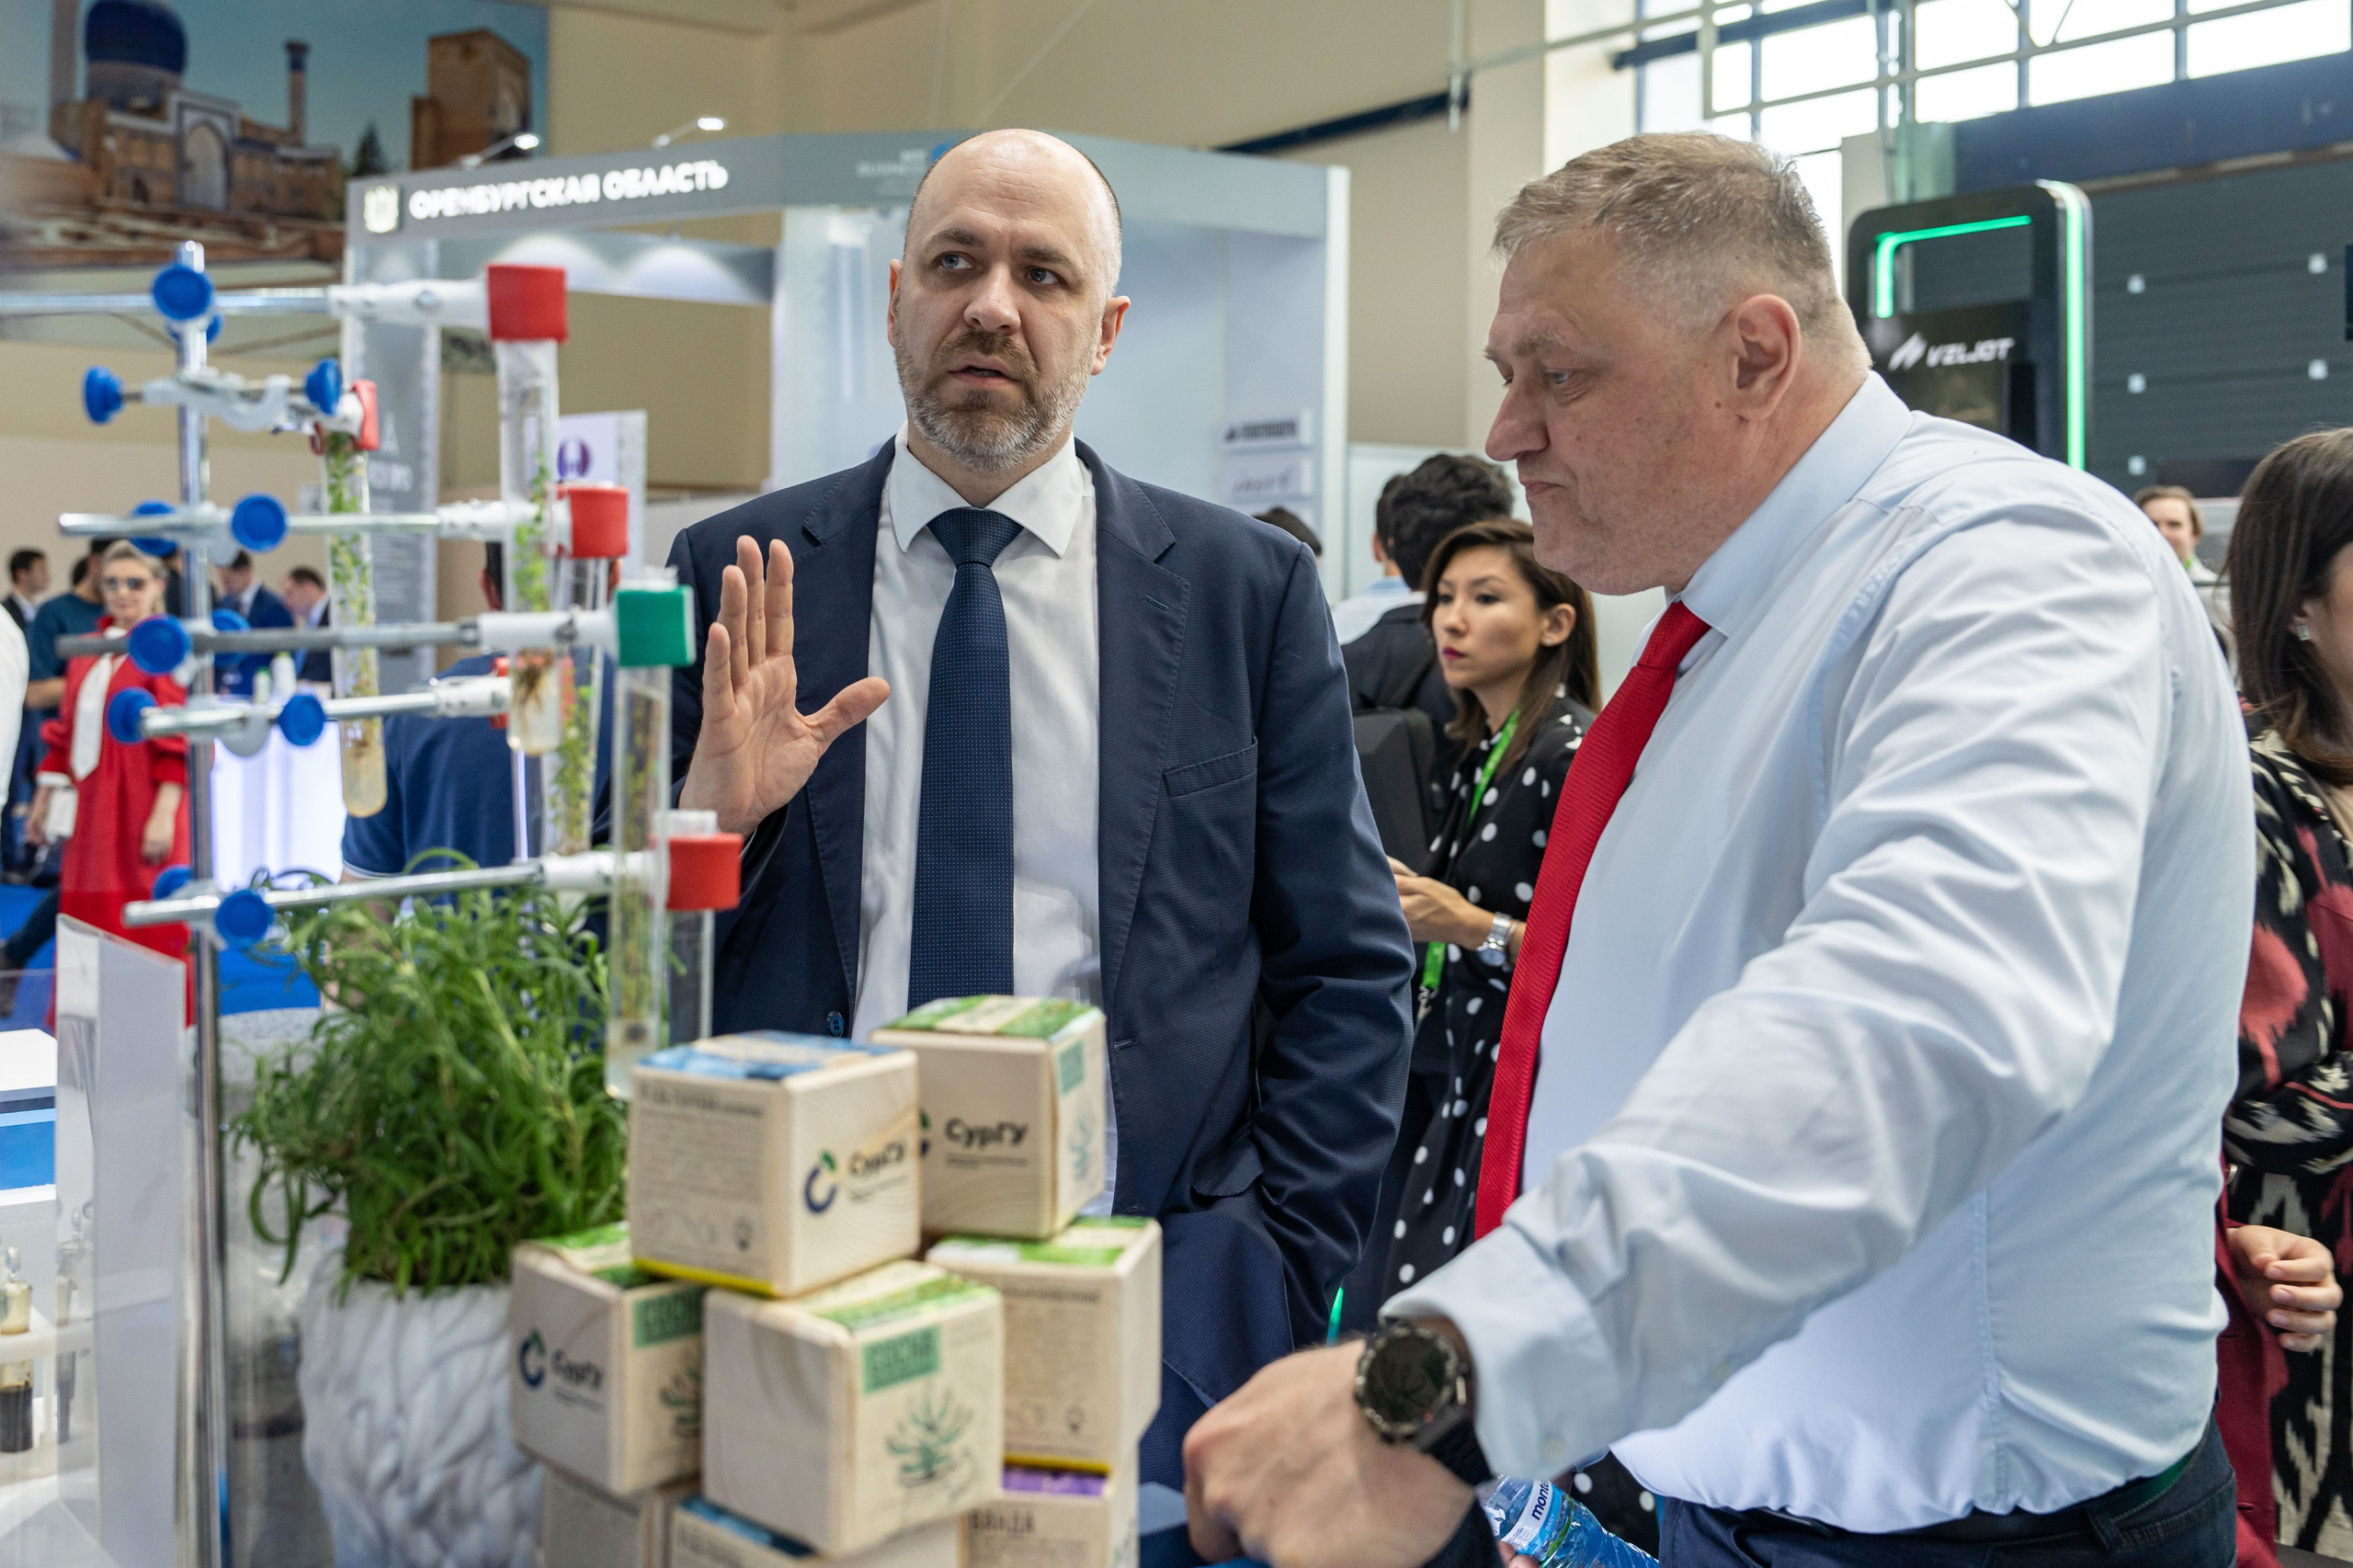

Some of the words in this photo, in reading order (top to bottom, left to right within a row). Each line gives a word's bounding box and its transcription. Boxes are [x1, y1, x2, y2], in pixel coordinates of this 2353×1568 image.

[602, 160, 729, 200] ОБЛАСТЬ
[945, 1118, 1028, 1148] СурГУ
[1531, 1480, 1551, 1520] monte
